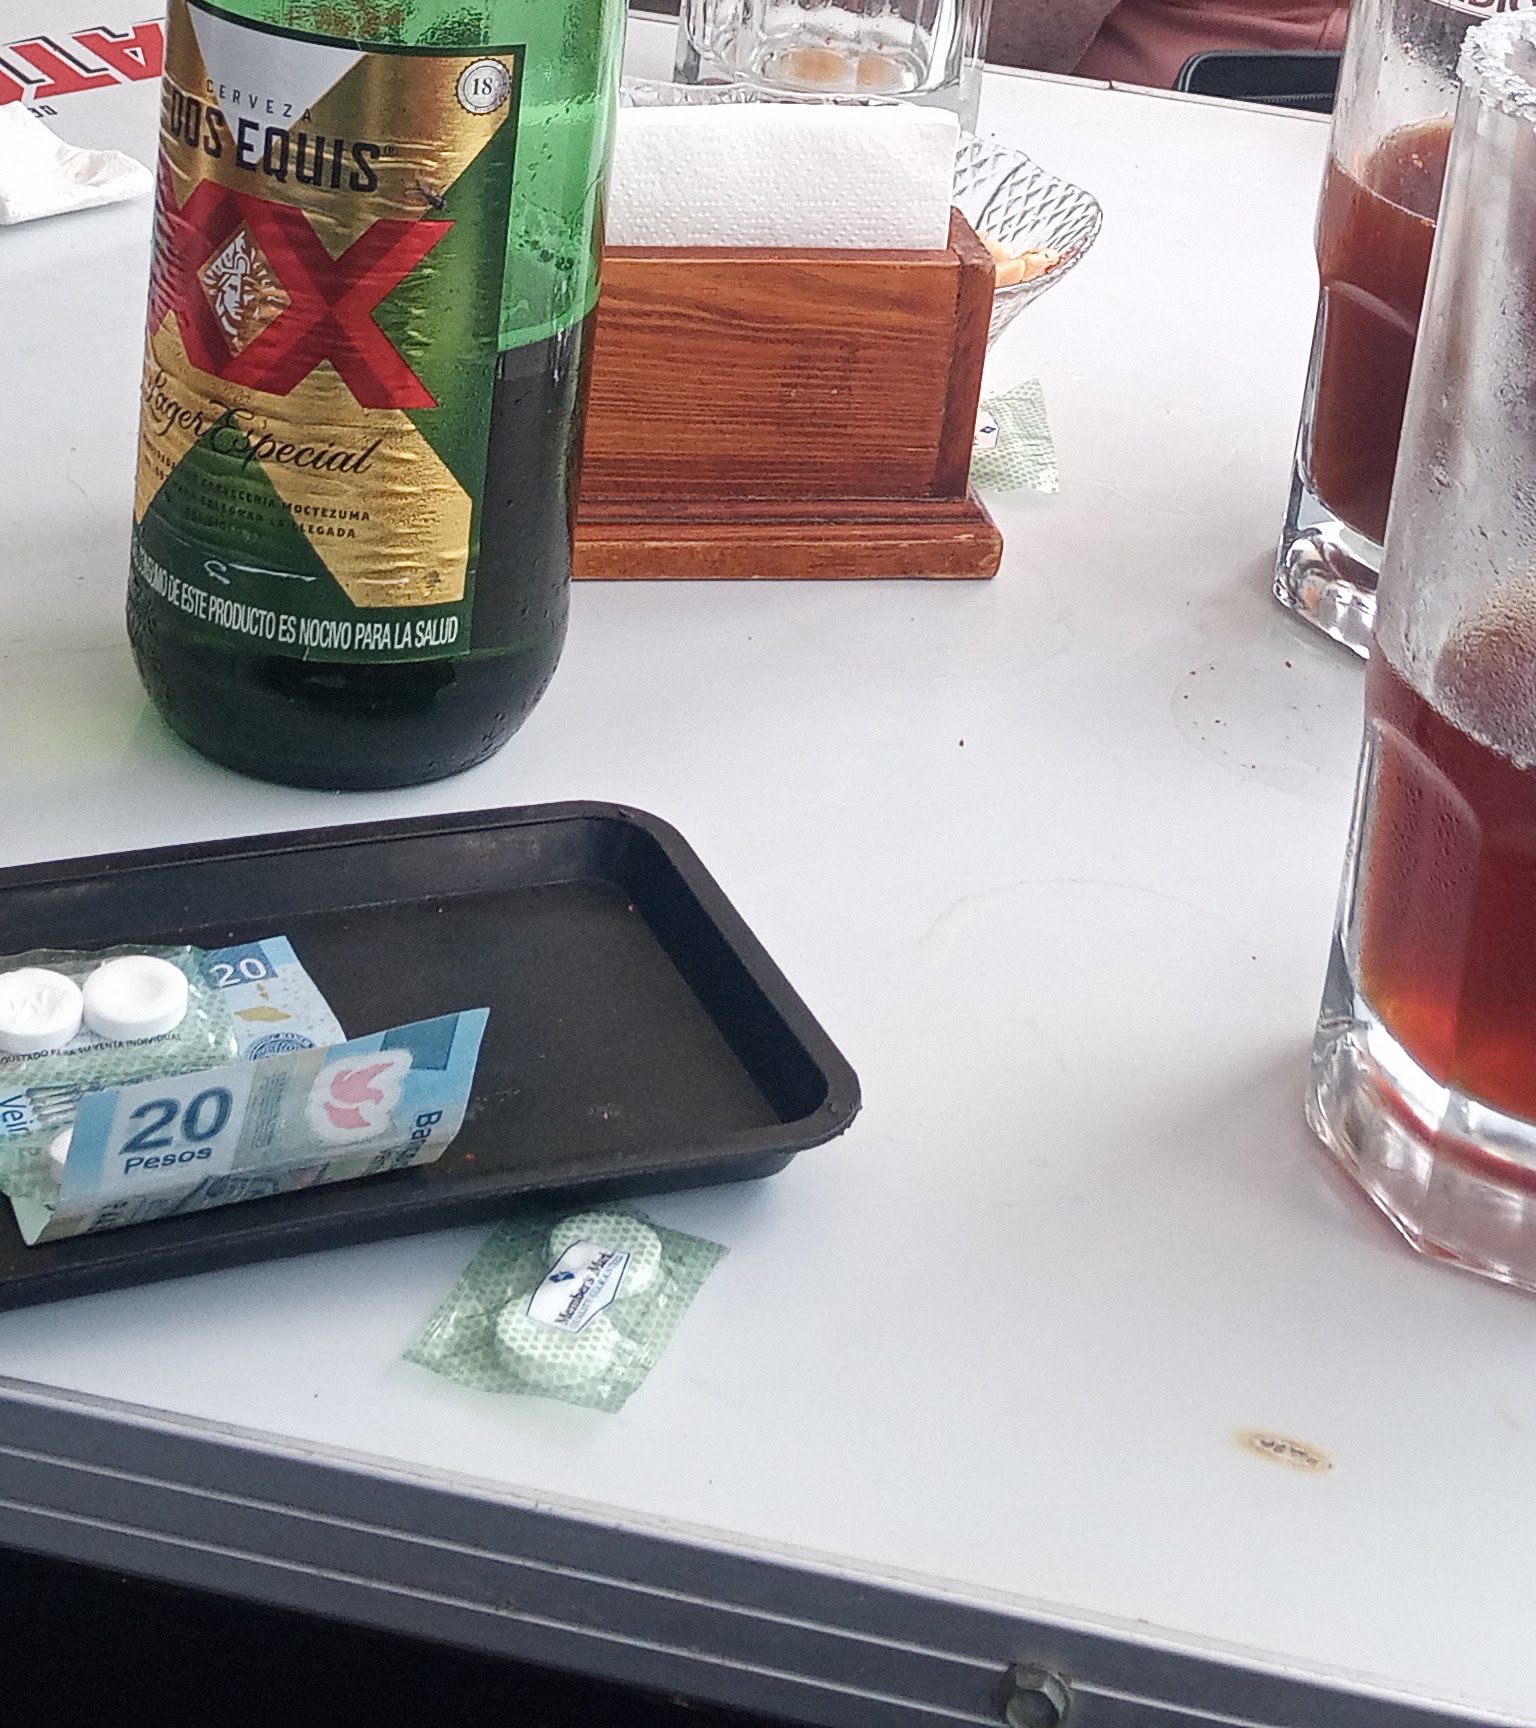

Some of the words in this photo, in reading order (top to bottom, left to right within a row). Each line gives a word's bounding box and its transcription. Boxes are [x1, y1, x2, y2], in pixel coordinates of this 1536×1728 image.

[206, 78, 314, 123] CERVEZA
[170, 86, 225, 158] DOS
[236, 116, 382, 192] EQUIS
[146, 369, 214, 440] Lager
[208, 398, 382, 474] Especial
[283, 501, 371, 522] MOCTEZUMA
[168, 575, 181, 606] DE
[181, 582, 207, 619] ESTE
[209, 593, 276, 641] PRODUCTO
[278, 614, 296, 644] ES
[299, 617, 352, 650] NOCIVO
[354, 622, 391, 651] PARA
[394, 623, 414, 650] LA
[414, 615, 459, 649] SALUD
[209, 955, 270, 989] 20
[77, 1045, 92, 1055] SU
[92, 1040, 125, 1053] VENTA
[126, 1032, 183, 1048] INDIVIDUAL
[119, 1086, 234, 1156] 20
[124, 1146, 213, 1174] Pesos
